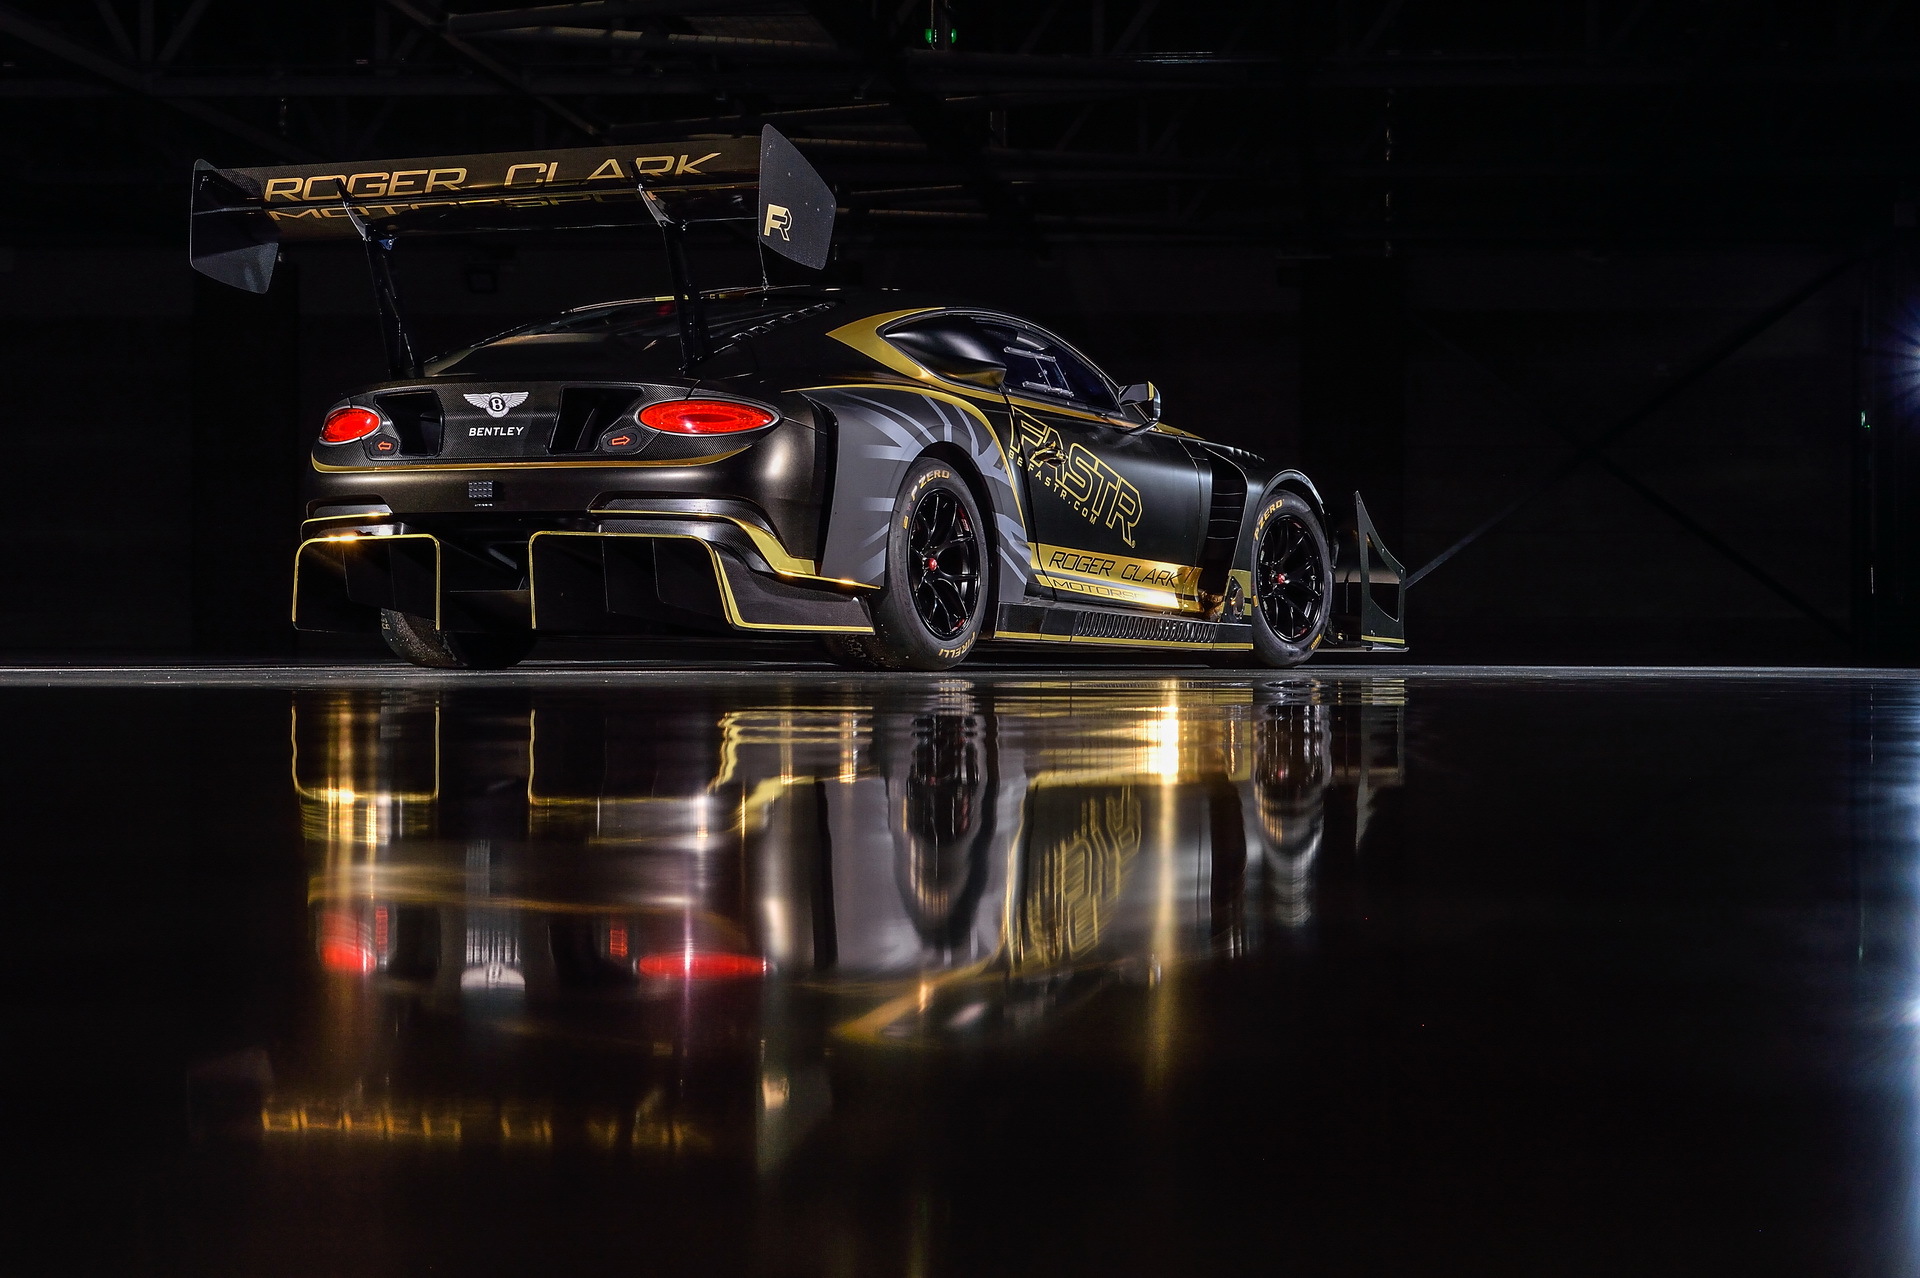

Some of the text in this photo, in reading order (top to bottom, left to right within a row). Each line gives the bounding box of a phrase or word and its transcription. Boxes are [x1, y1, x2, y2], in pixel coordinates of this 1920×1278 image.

[264, 152, 721, 202] ROGER CLARK
[468, 426, 524, 437] BENTLEY
[918, 469, 950, 489] ZERO
[1009, 405, 1143, 548] FASTR
[1258, 499, 1284, 530] ZERO
[1049, 551, 1183, 588] ROGER CLARK
